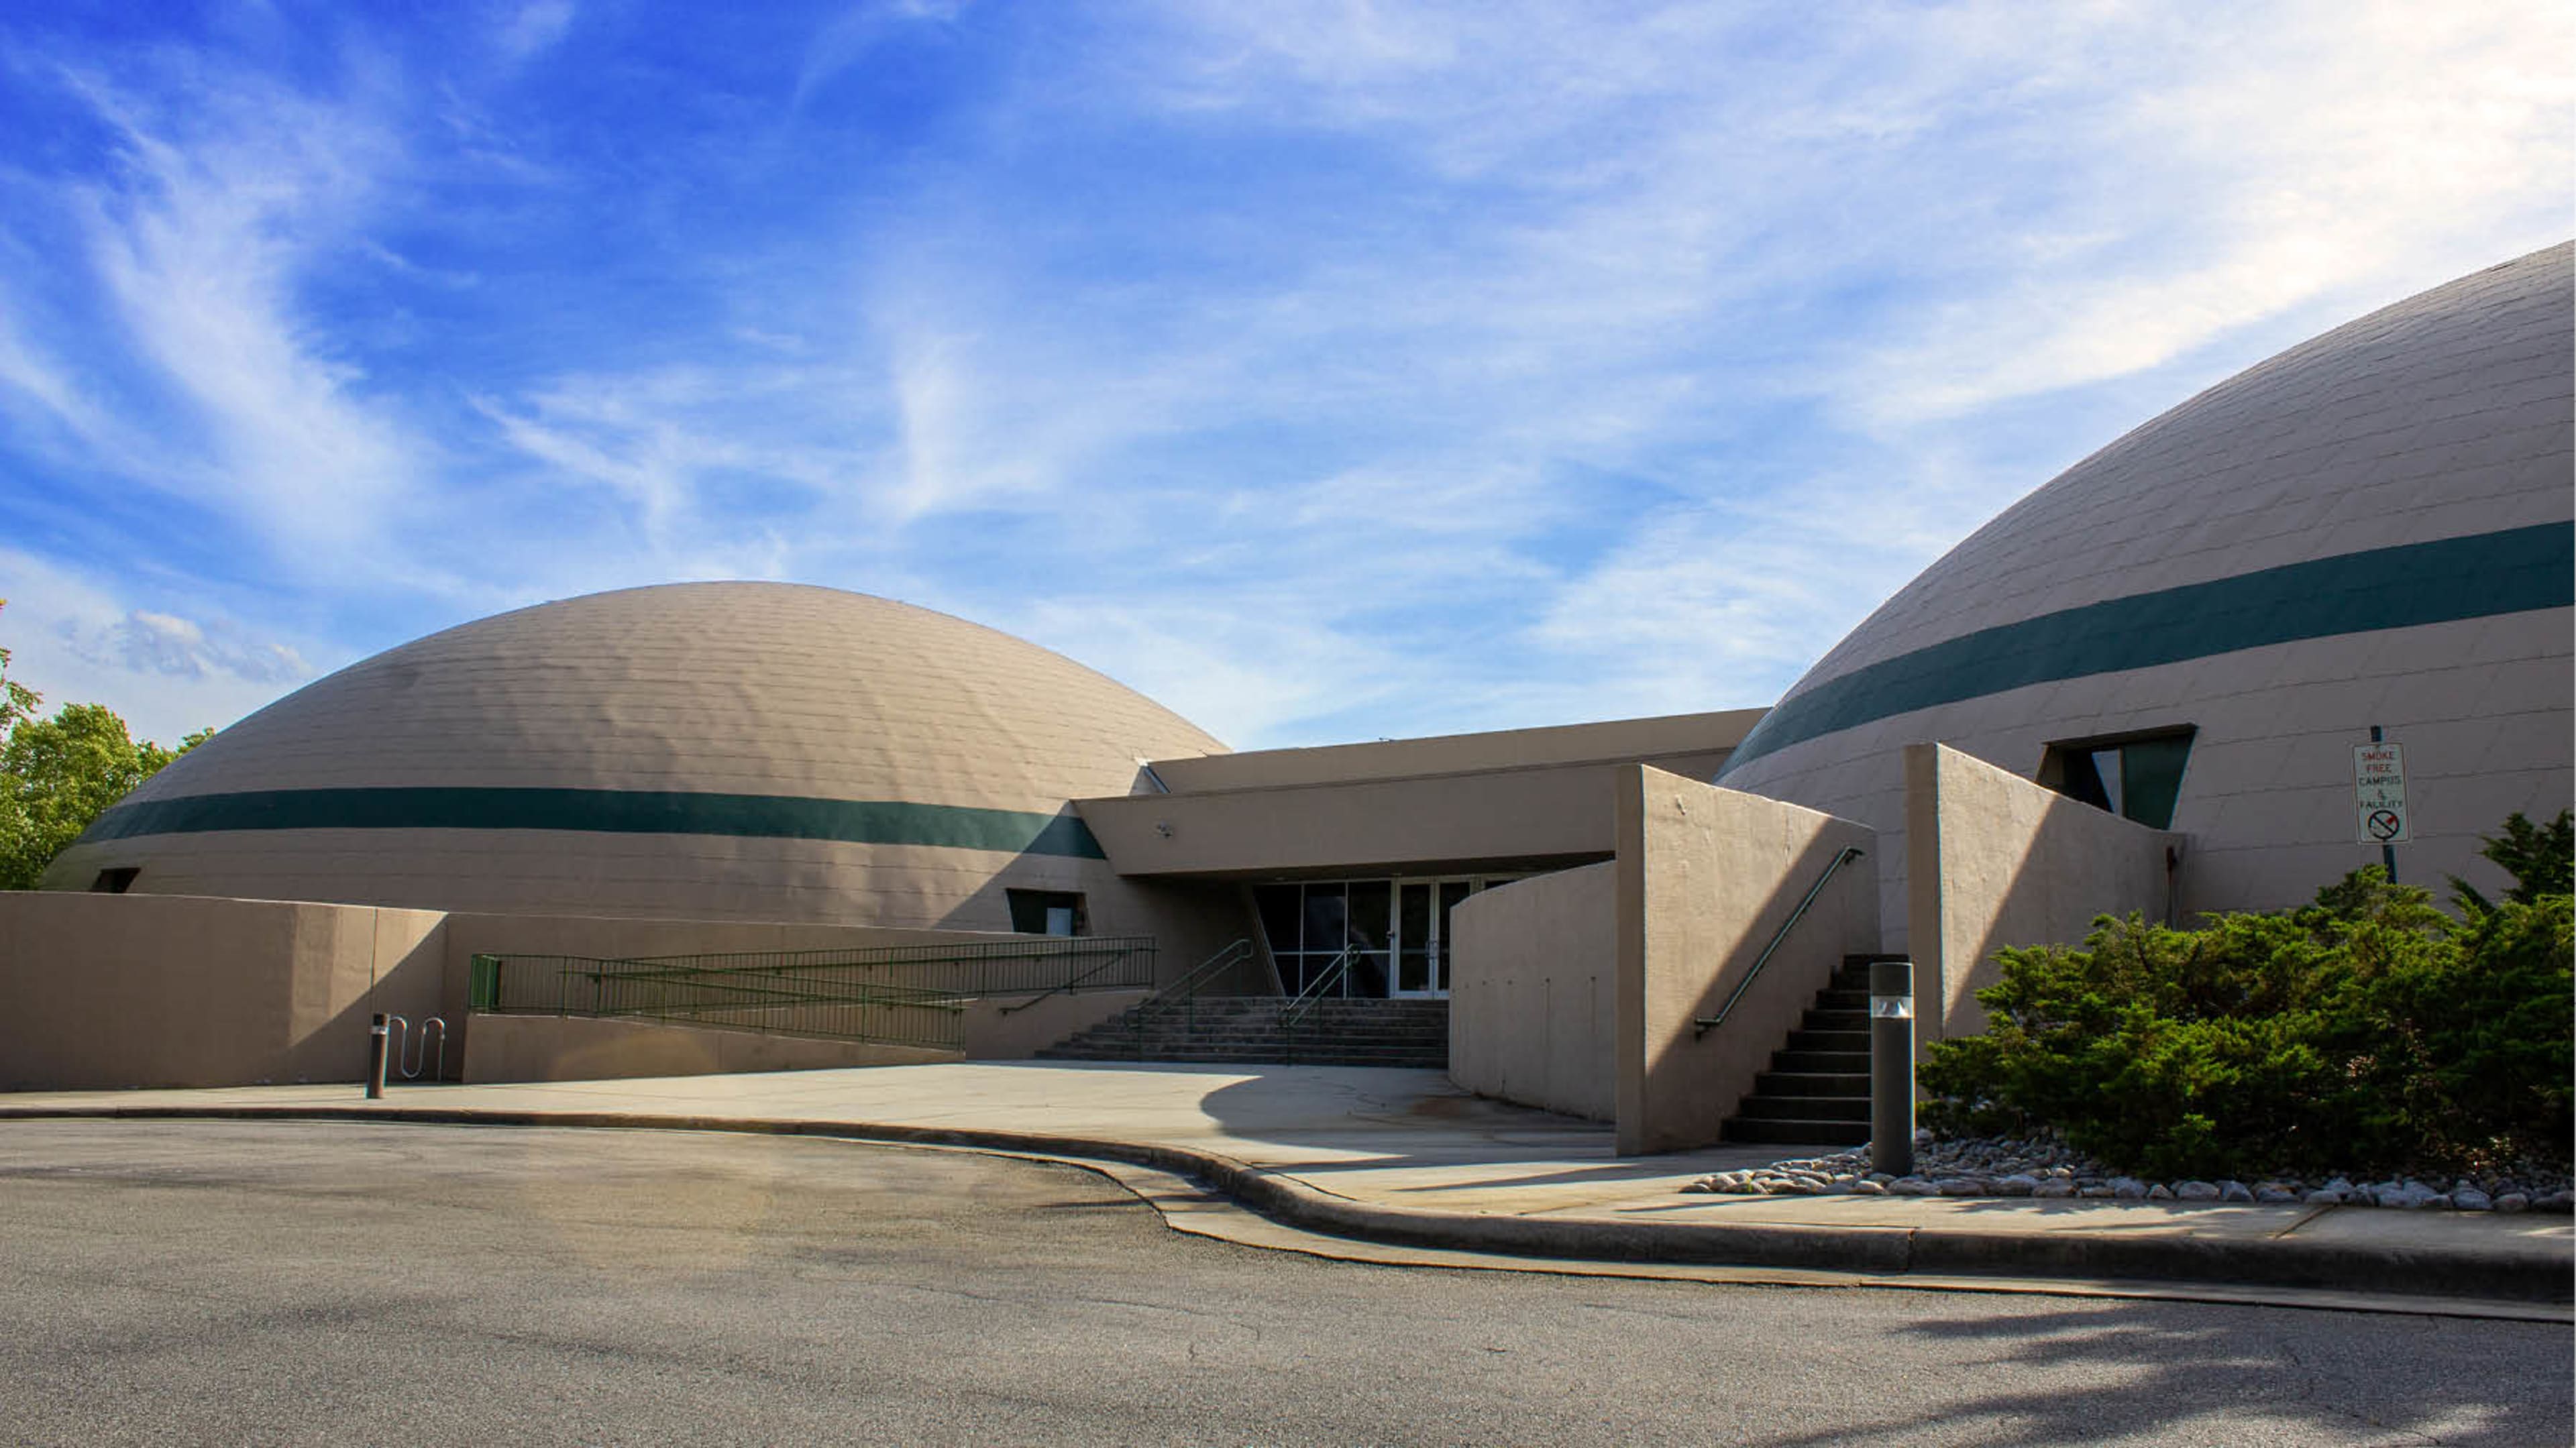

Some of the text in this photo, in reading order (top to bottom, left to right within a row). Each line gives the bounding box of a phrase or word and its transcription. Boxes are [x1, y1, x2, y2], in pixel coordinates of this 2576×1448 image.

[2361, 751, 2394, 761] SMOKE
[2366, 764, 2392, 773] FREE
[2359, 775, 2401, 786] CAMPUS
[2359, 800, 2403, 808] FACILITY
